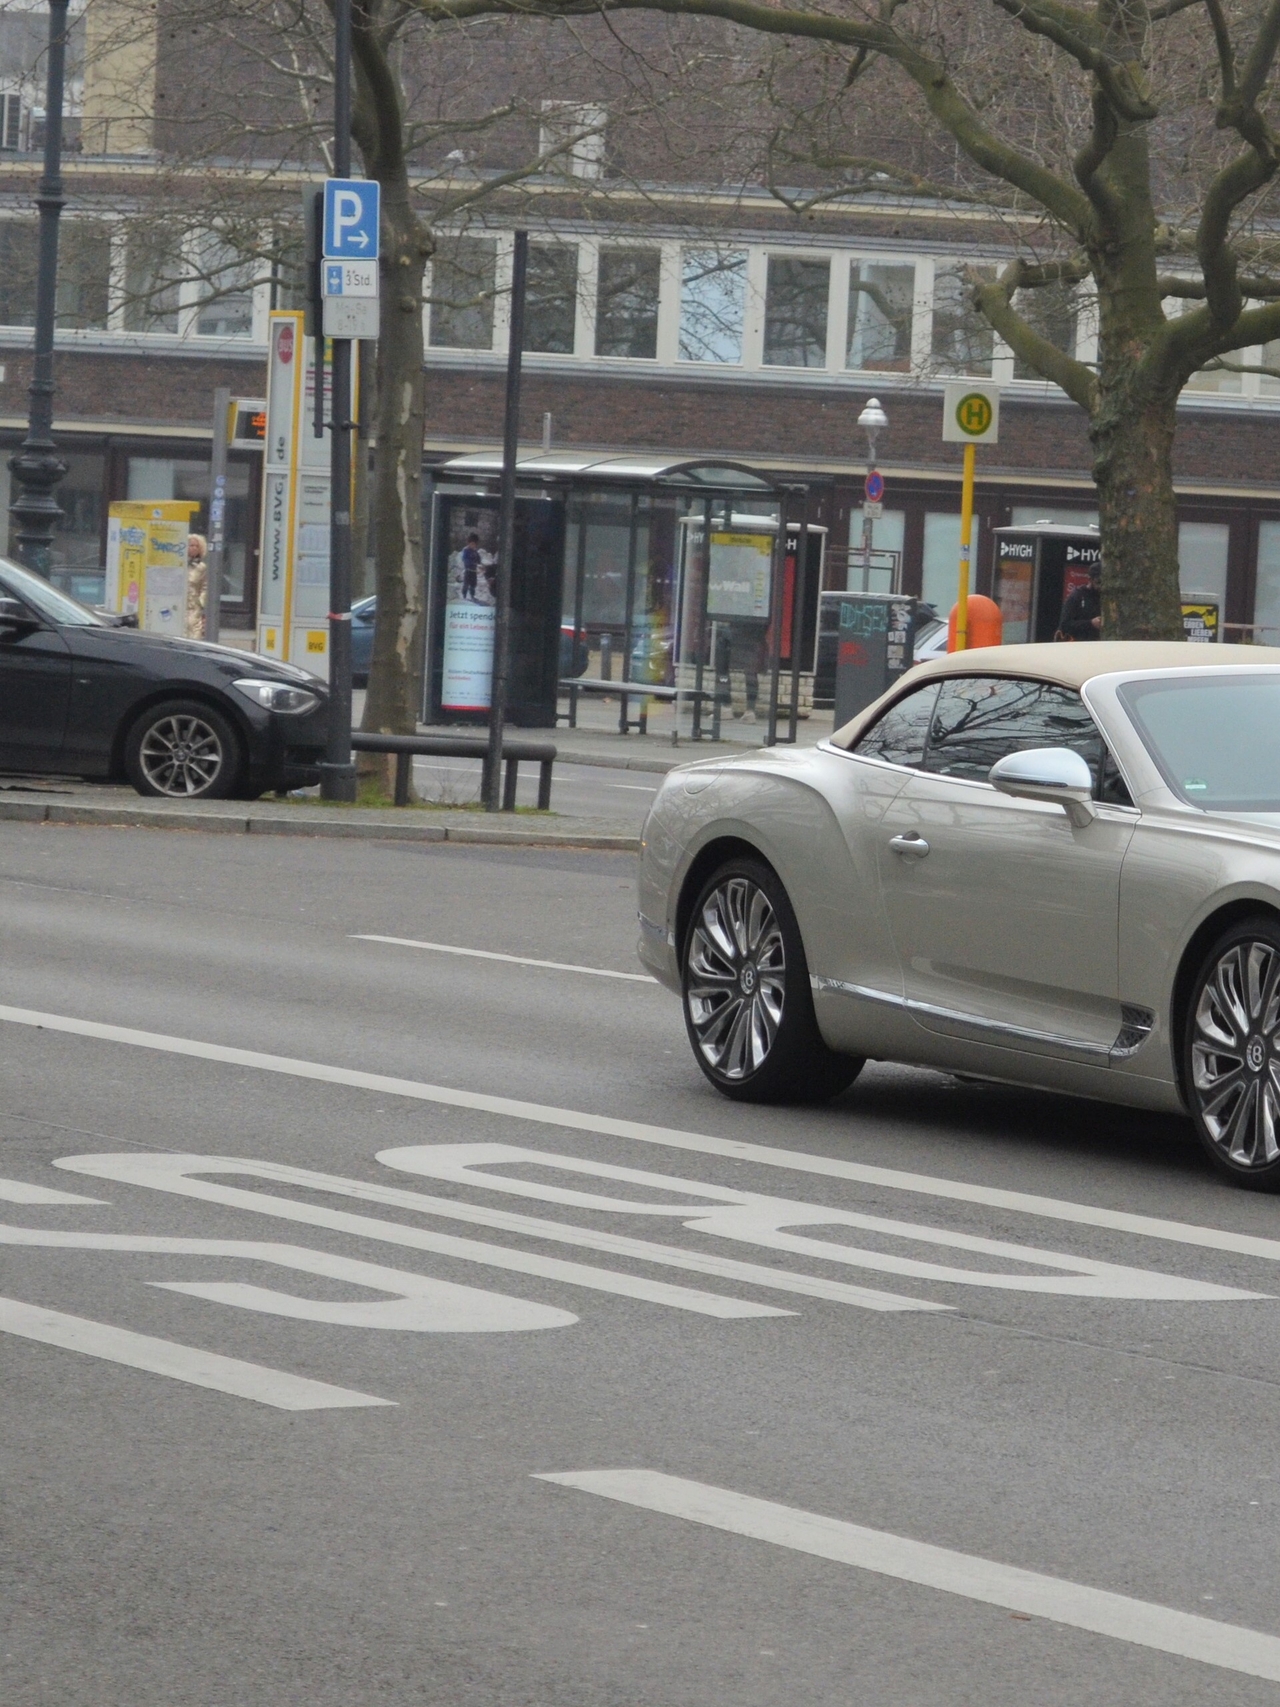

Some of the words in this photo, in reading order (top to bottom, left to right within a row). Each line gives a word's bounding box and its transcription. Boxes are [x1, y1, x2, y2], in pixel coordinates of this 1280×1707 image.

[333, 190, 362, 247] P
[345, 274, 352, 286] 3
[354, 274, 372, 286] Std.
[965, 403, 984, 425] H
[1009, 543, 1033, 558] HYGH
[1080, 549, 1101, 562] HY
[449, 610, 468, 620] Jetzt
[470, 611, 495, 622] spend
